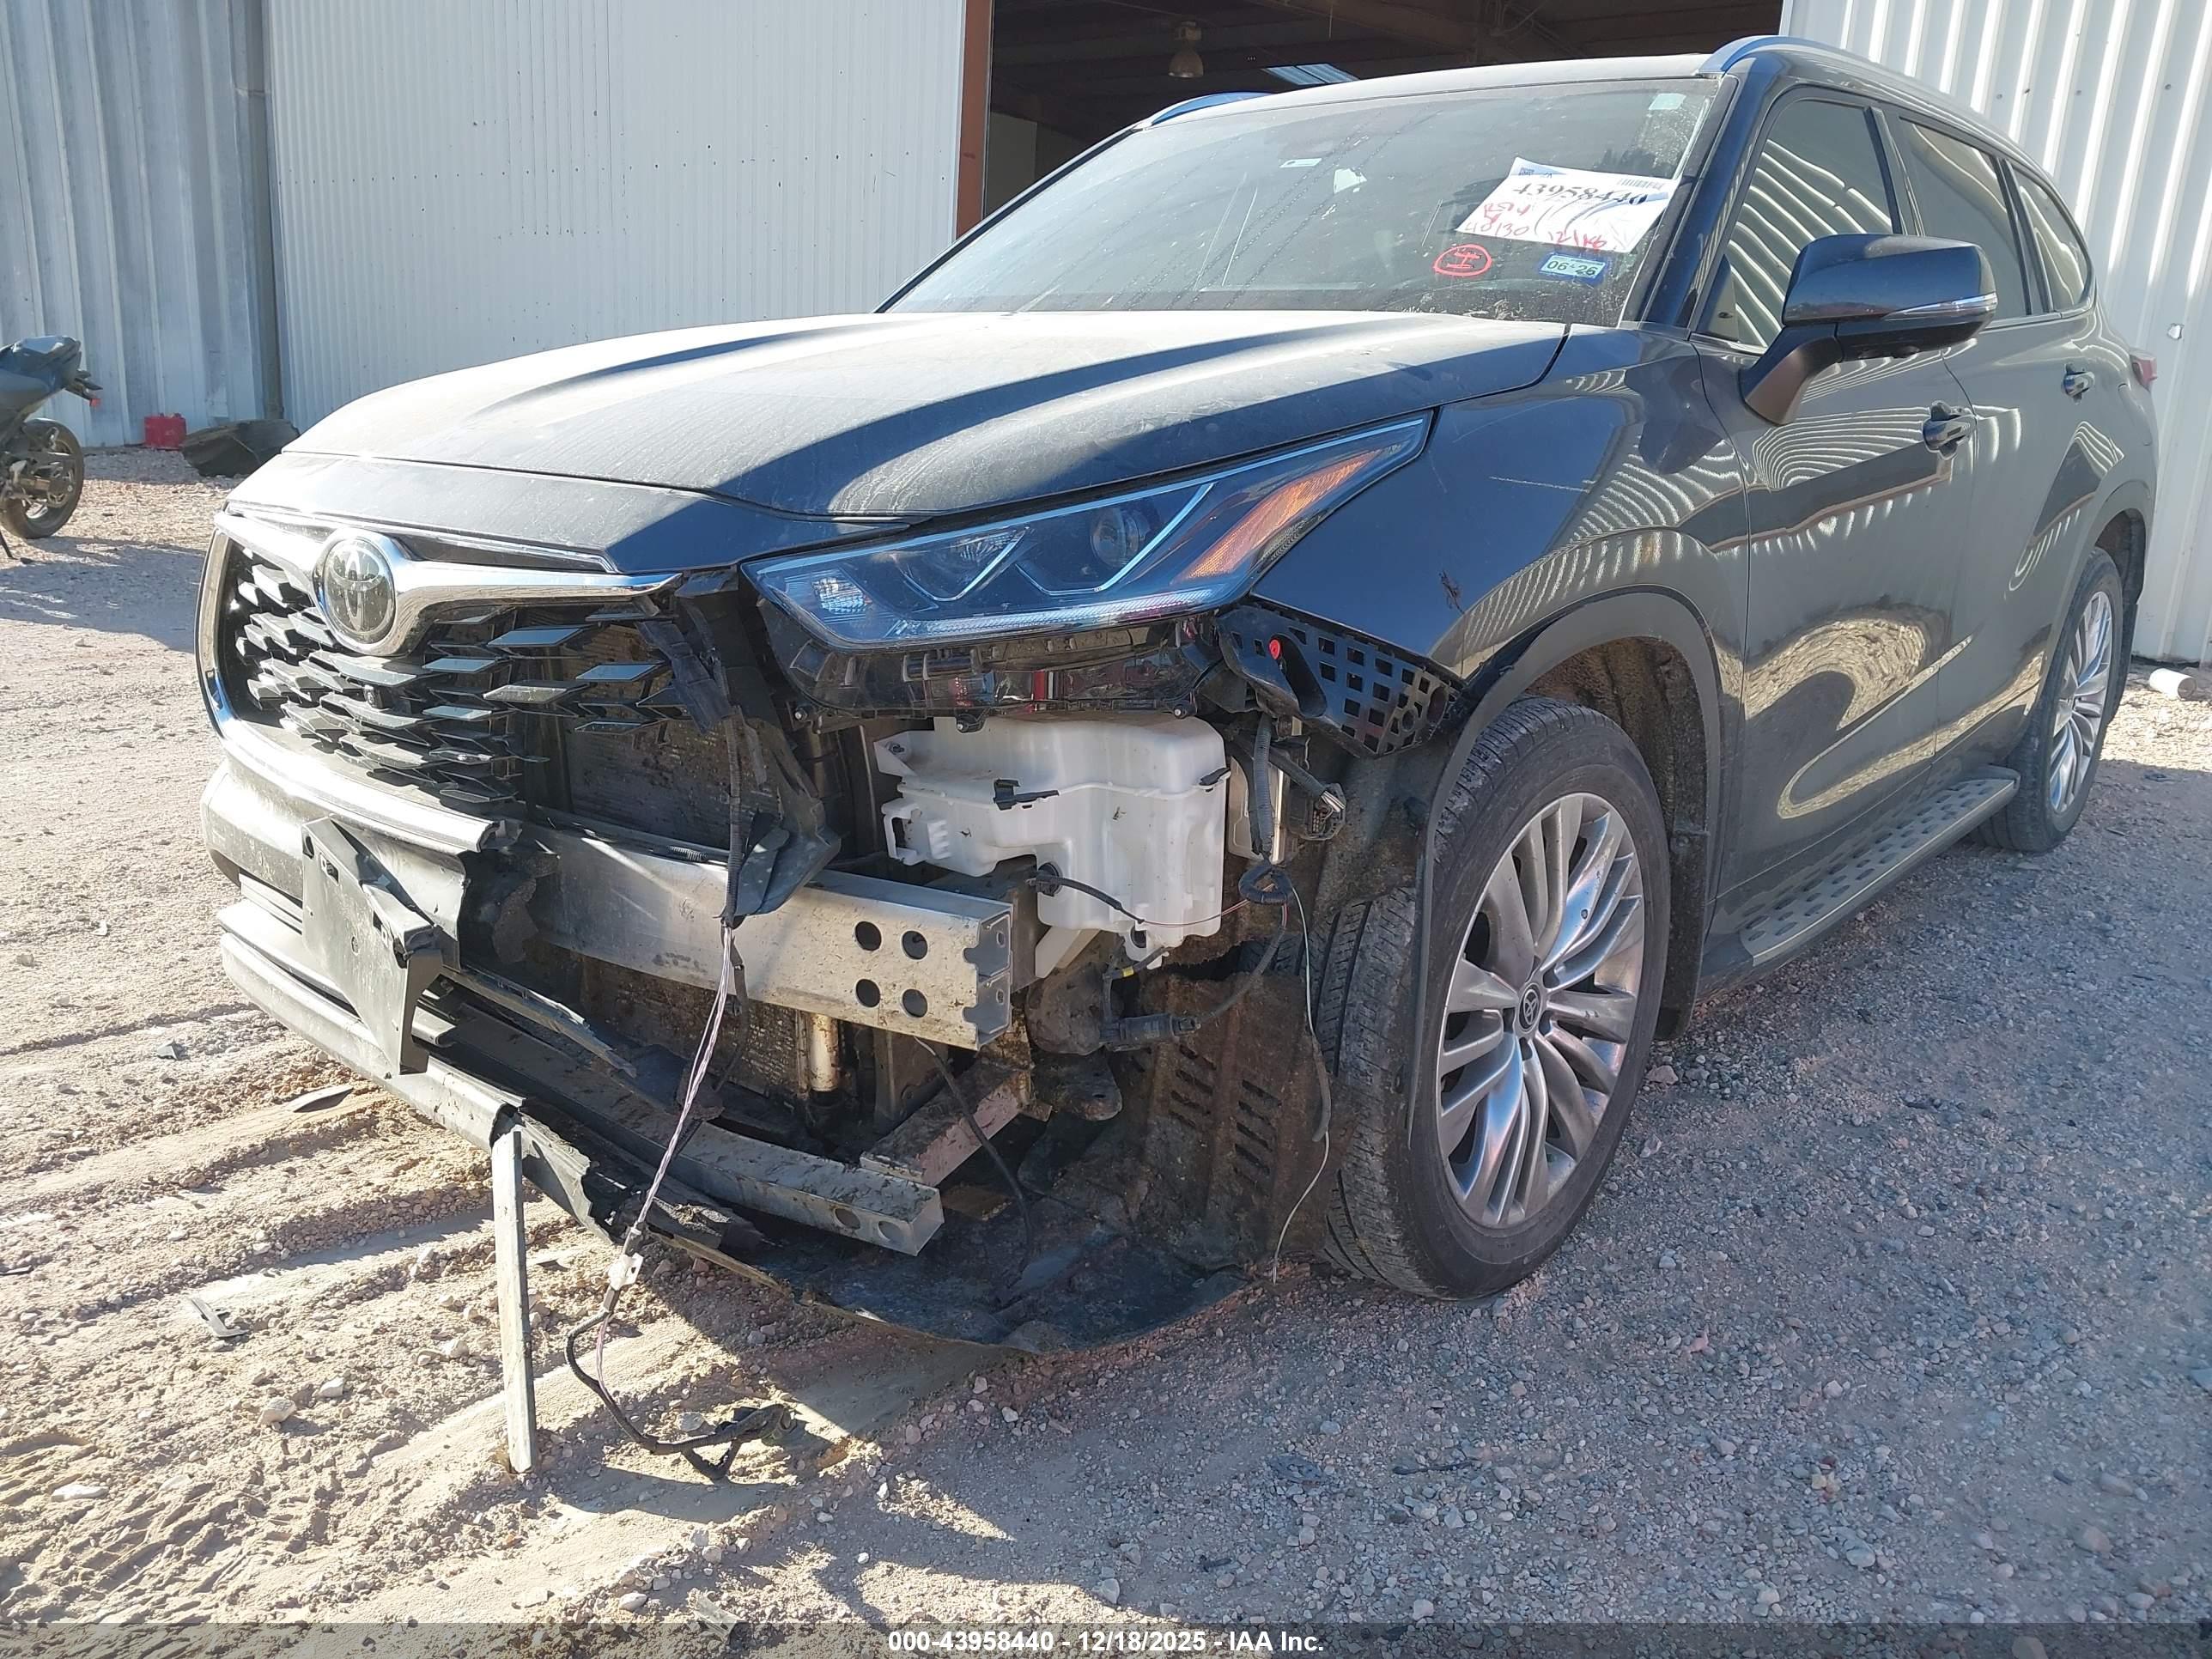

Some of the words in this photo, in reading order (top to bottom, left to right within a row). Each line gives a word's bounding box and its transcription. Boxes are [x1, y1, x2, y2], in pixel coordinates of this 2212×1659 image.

[1513, 182, 1648, 205] 43958440
[1547, 260, 1568, 271] 06
[1575, 264, 1599, 276] 26
